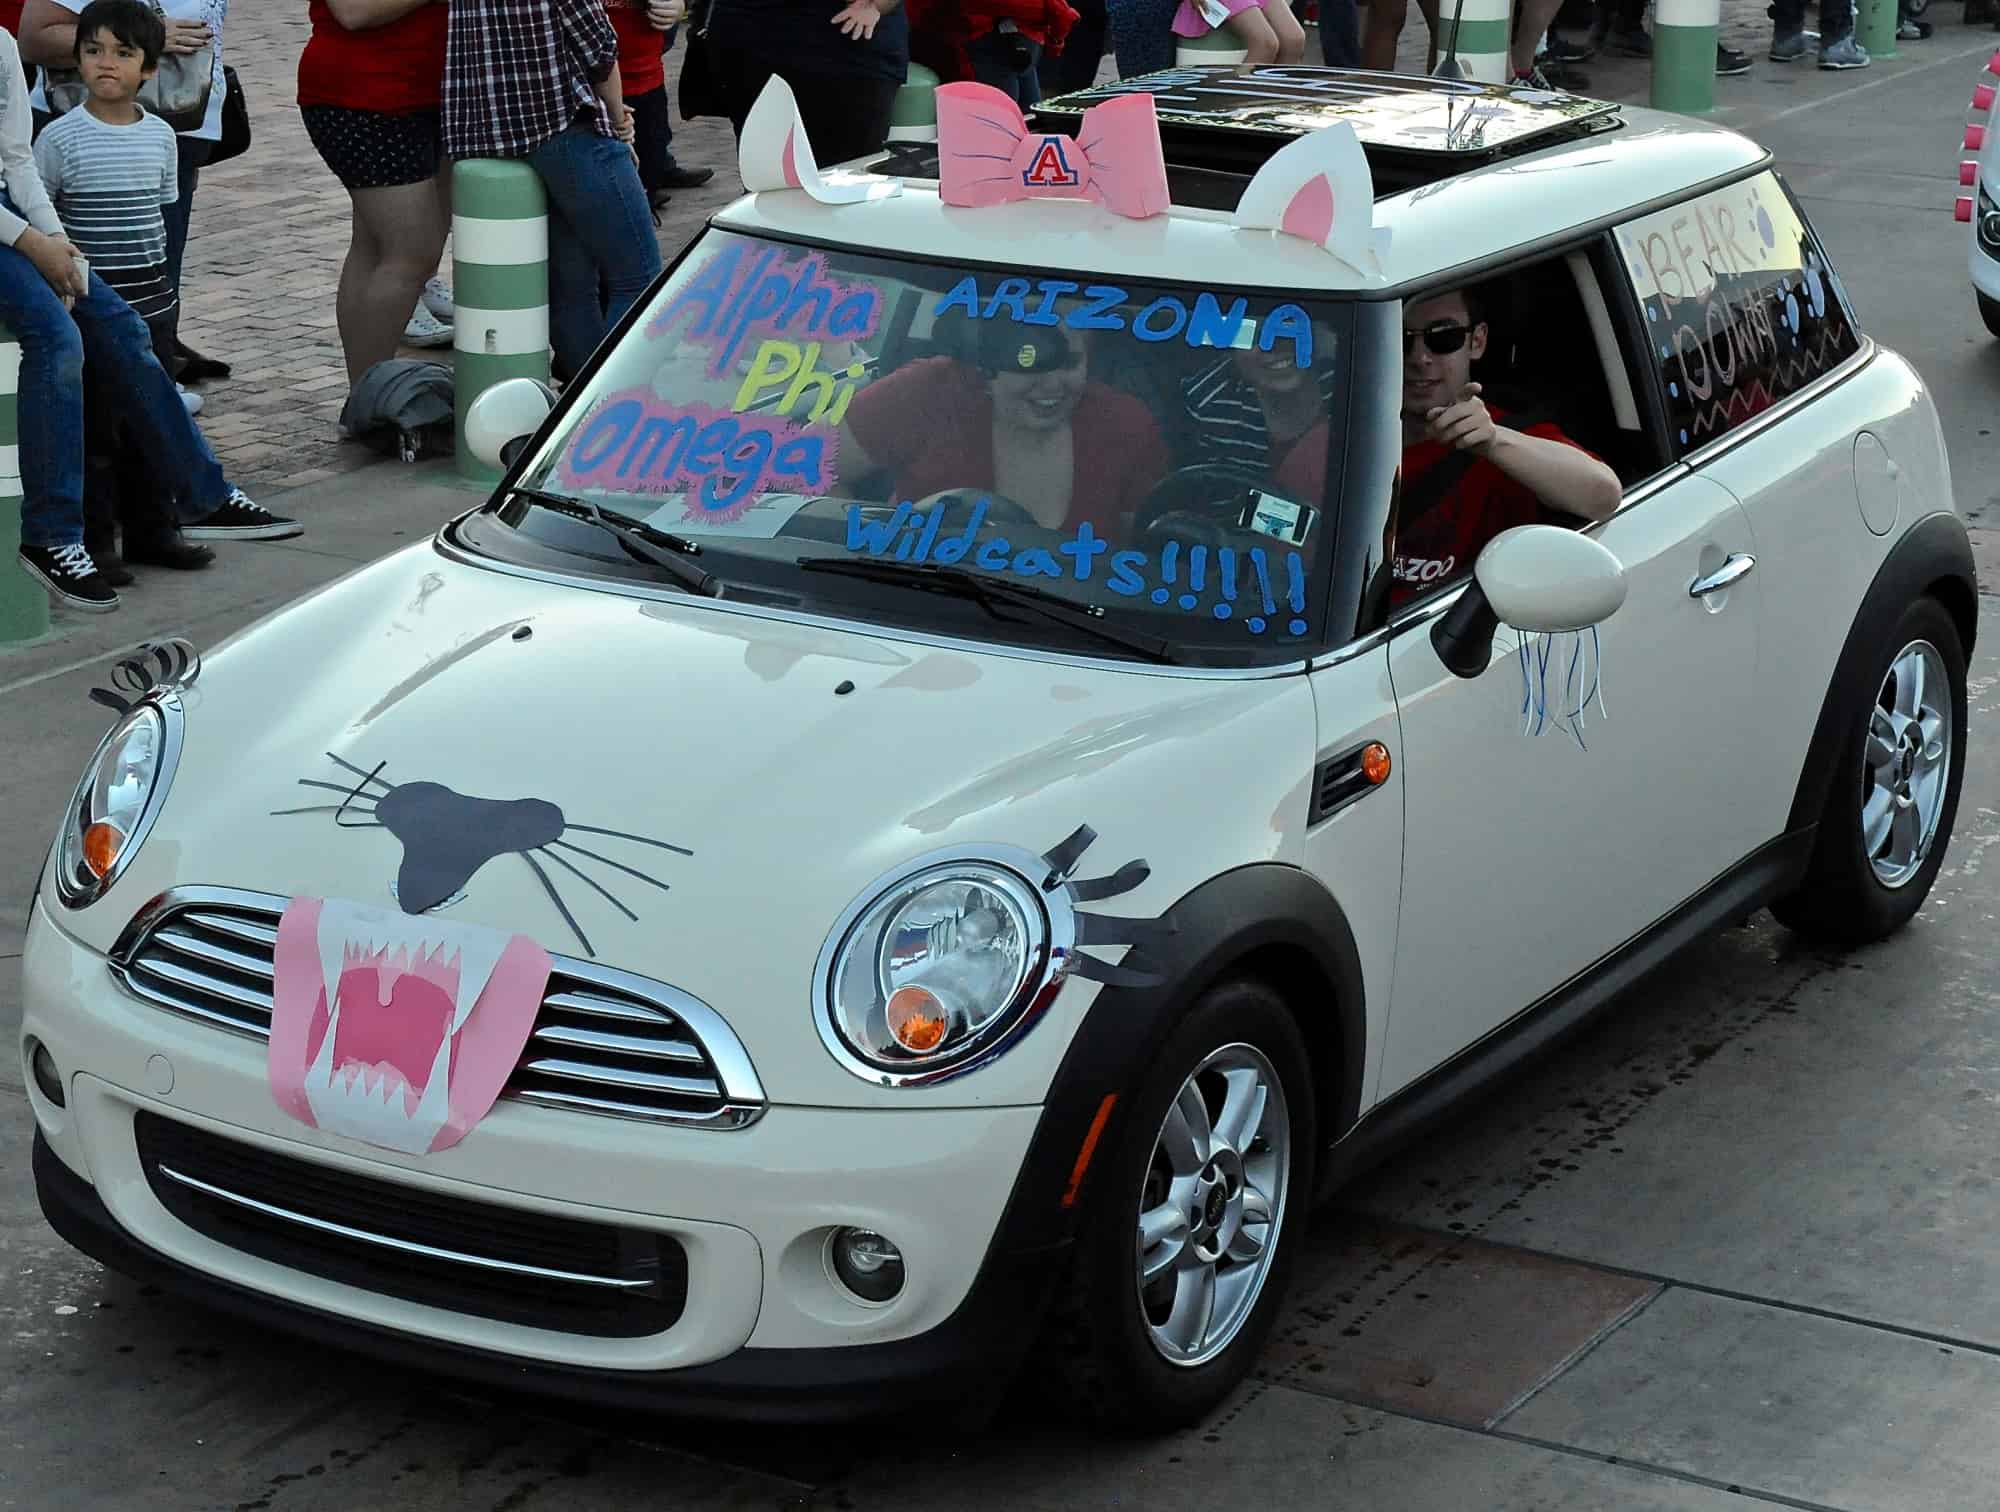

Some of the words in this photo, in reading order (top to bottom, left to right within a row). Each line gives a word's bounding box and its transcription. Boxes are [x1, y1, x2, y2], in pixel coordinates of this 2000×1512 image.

[1022, 136, 1078, 187] A
[655, 243, 878, 374] Alpha
[1639, 202, 1757, 321] BEAR
[934, 276, 1314, 369] ARIZONA
[733, 340, 865, 426] Phi
[570, 399, 825, 512] Omega
[845, 497, 1308, 636] Wildcats!!!!!
